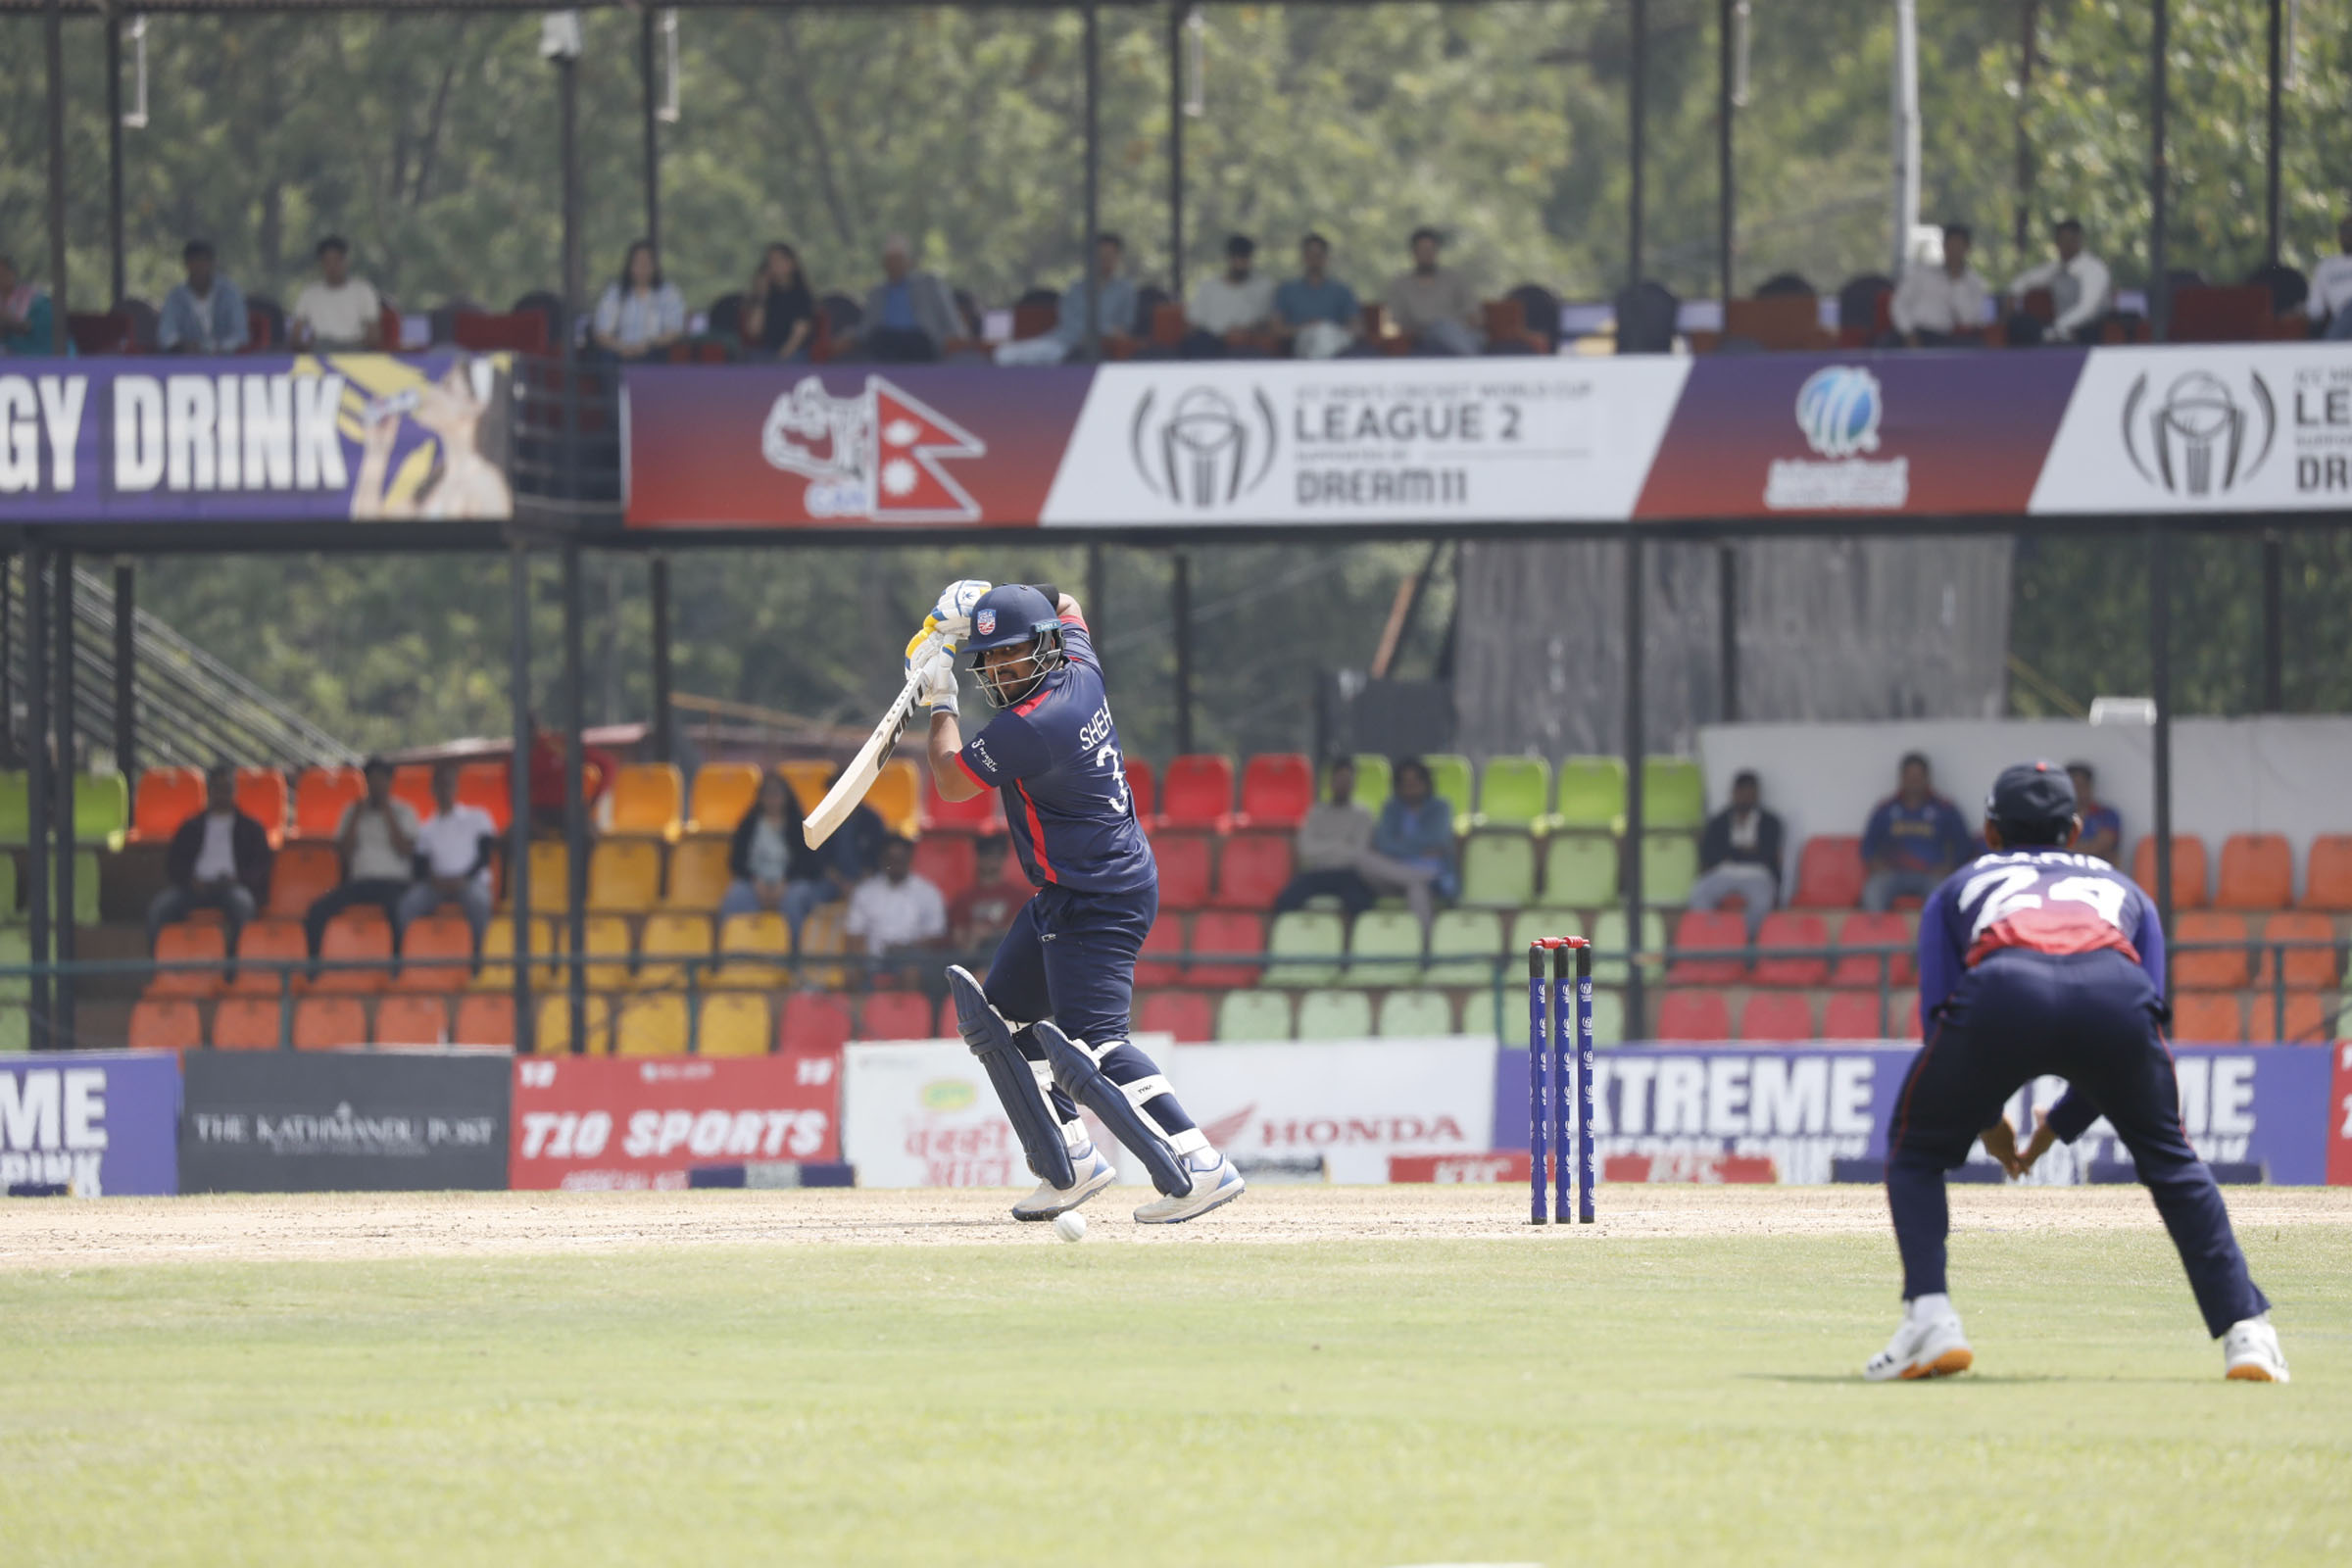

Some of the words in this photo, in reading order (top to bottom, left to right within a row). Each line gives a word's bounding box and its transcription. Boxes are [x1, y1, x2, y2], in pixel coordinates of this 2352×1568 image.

[114, 374, 348, 491] DRINK
[1294, 403, 1484, 443] LEAGUE
[1498, 402, 1523, 442] 2
[1295, 466, 1468, 506] DREAM11
[0, 1067, 108, 1151] ME
[1568, 1055, 1875, 1136] XTREME
[194, 1113, 249, 1144] THE
[521, 1111, 612, 1159] T10
[622, 1109, 828, 1158] SPORTS
[1260, 1114, 1466, 1147] HONDA
